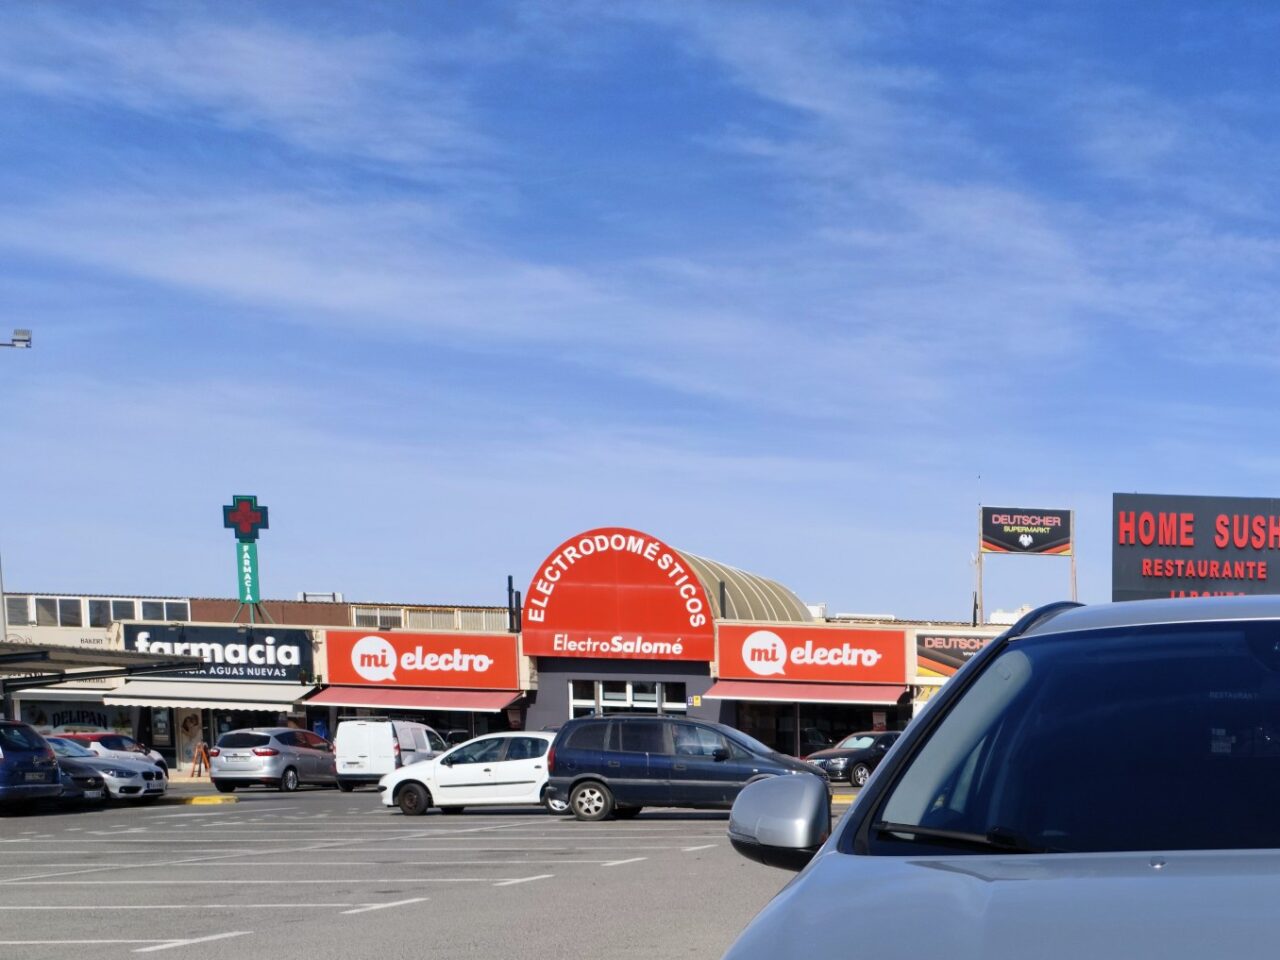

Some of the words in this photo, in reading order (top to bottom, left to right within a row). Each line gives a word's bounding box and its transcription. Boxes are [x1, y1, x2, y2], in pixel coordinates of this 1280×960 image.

[992, 514, 1061, 526] DEUTSCHER
[1118, 511, 1195, 546] HOME
[242, 545, 253, 601] FARMACIA
[528, 534, 706, 627] ELECTRODOMÉSTICOS
[1141, 558, 1267, 580] RESTAURANTE
[553, 634, 683, 654] ElectroSalomé
[750, 643, 779, 662] mi
[790, 640, 882, 666] electro
[360, 649, 390, 668] mi
[400, 645, 493, 672] electro
[209, 667, 244, 675] AGUAS
[247, 668, 287, 677] NUEVAS
[52, 710, 108, 729] DELIPAN
